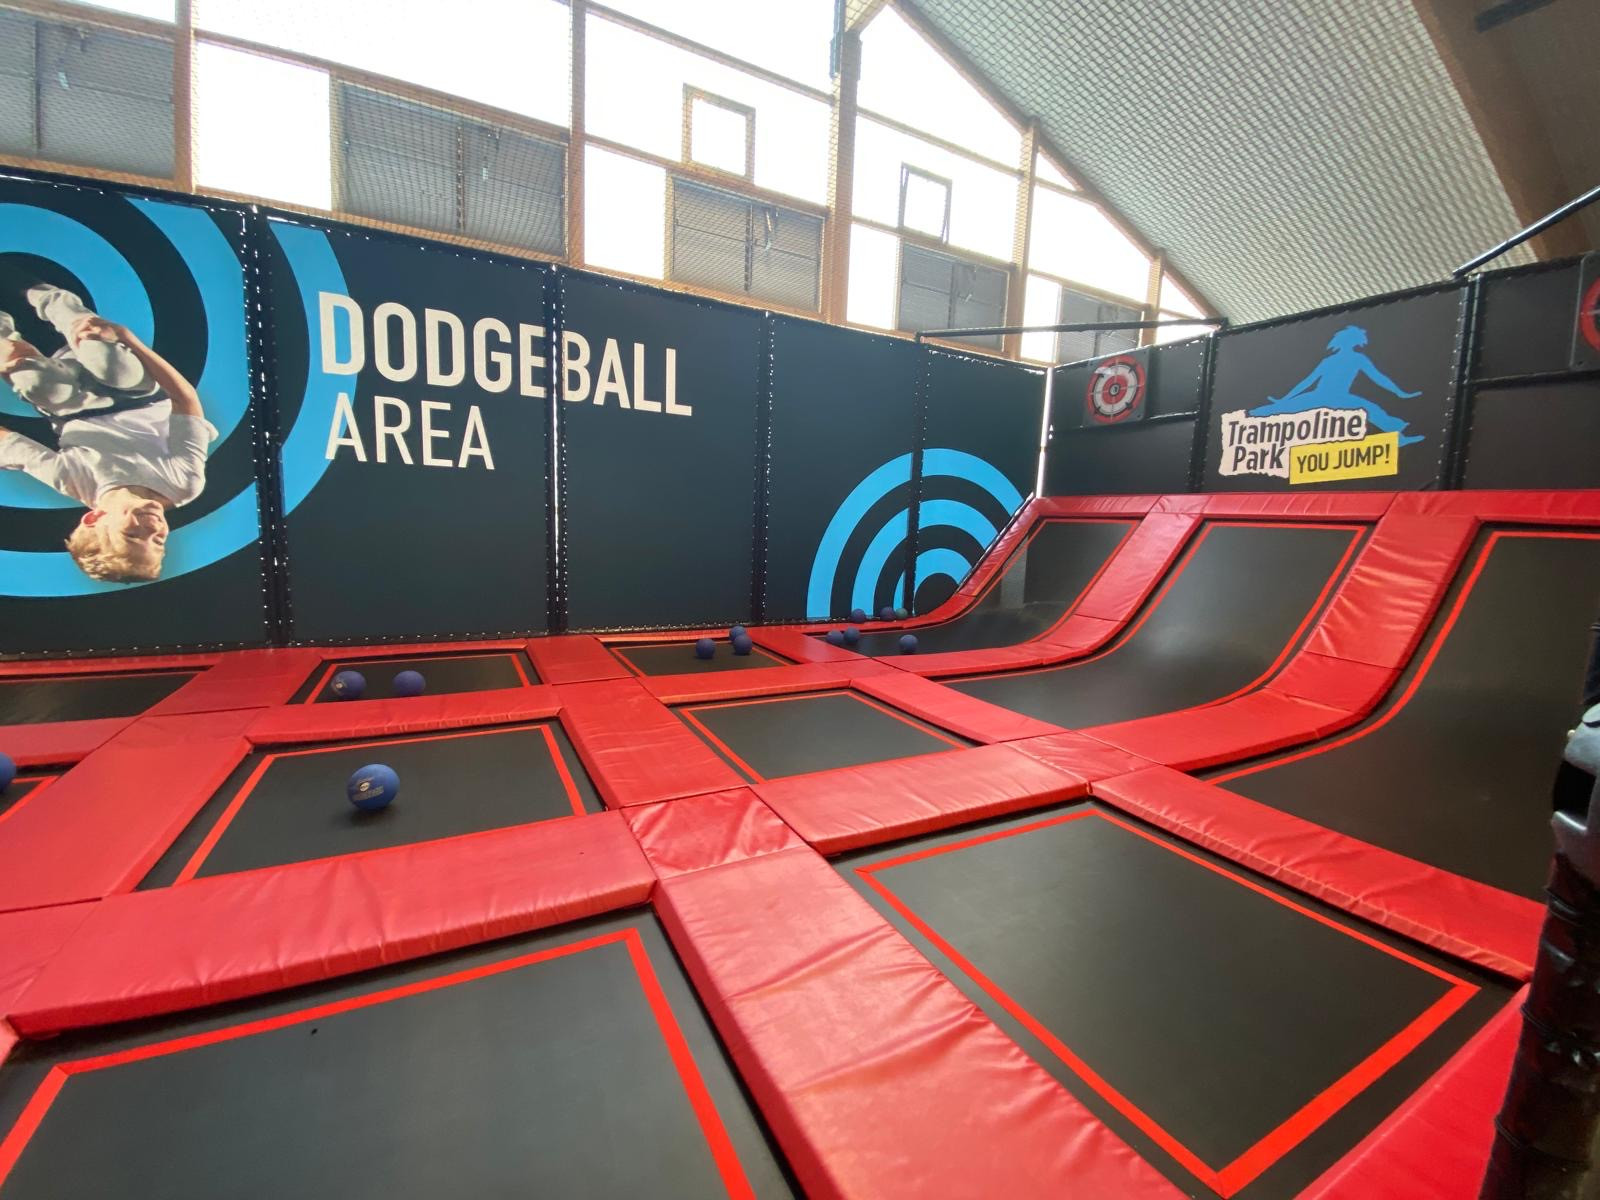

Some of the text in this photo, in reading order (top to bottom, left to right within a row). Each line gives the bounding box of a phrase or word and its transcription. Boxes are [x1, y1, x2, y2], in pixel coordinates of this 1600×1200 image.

[325, 392, 495, 470] AREA
[1229, 411, 1362, 448] Trampoline
[1232, 445, 1286, 471] Park
[1297, 443, 1390, 473] YOU JUMP!
